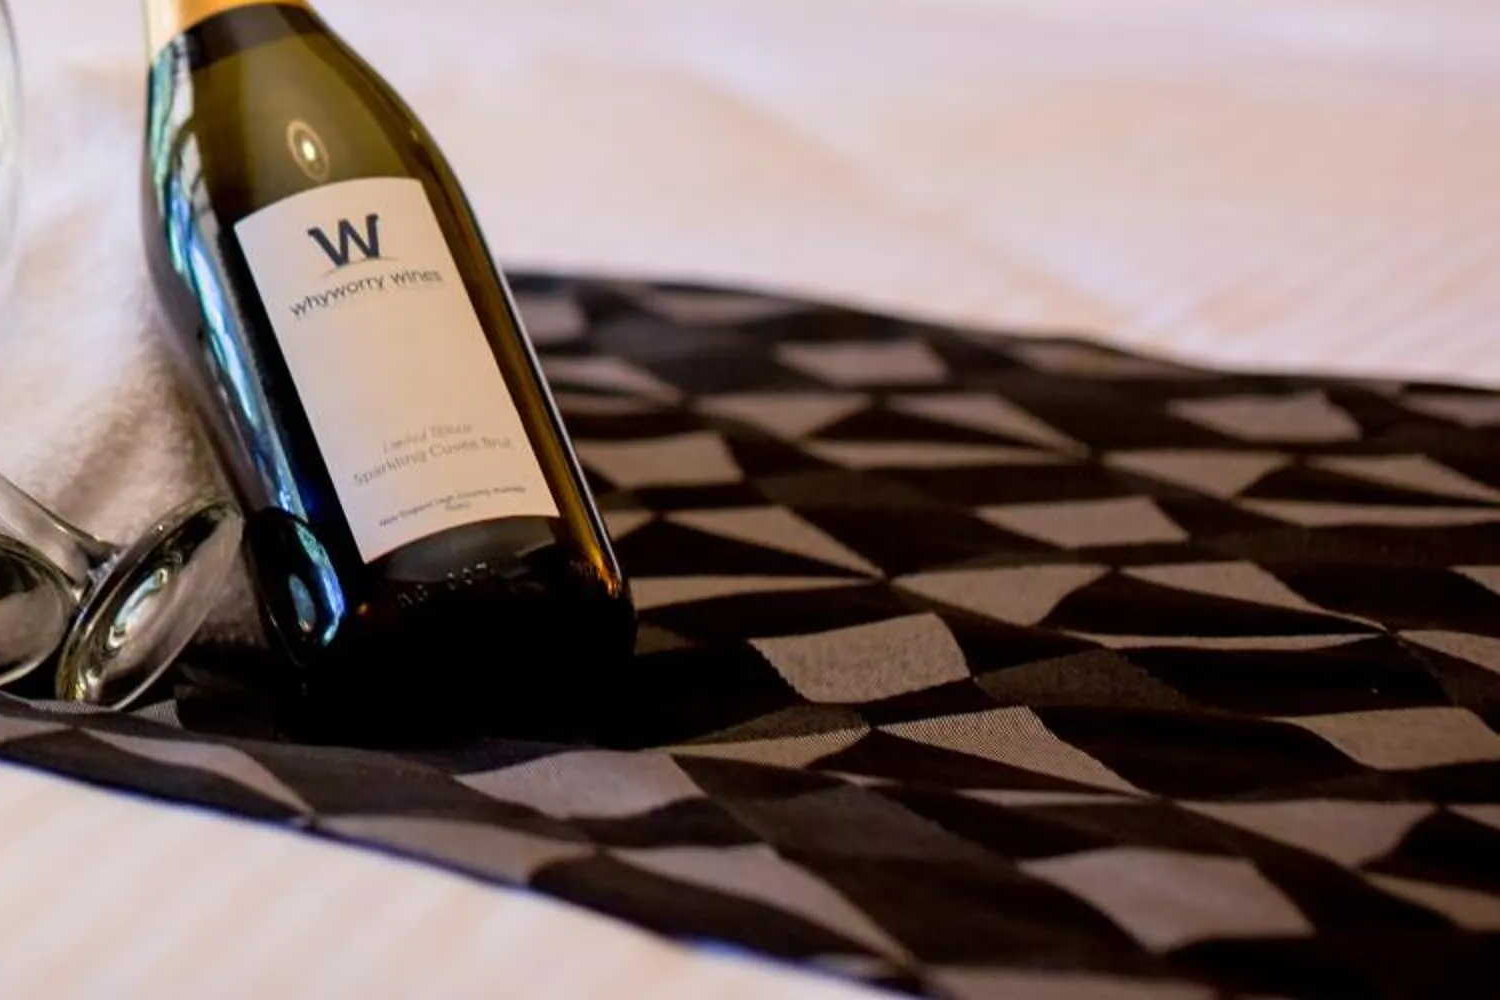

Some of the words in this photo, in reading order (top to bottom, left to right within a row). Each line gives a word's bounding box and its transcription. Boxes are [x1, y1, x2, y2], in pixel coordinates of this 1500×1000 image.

[307, 213, 380, 267] W
[289, 275, 385, 317] whyworry
[389, 270, 443, 286] wines
